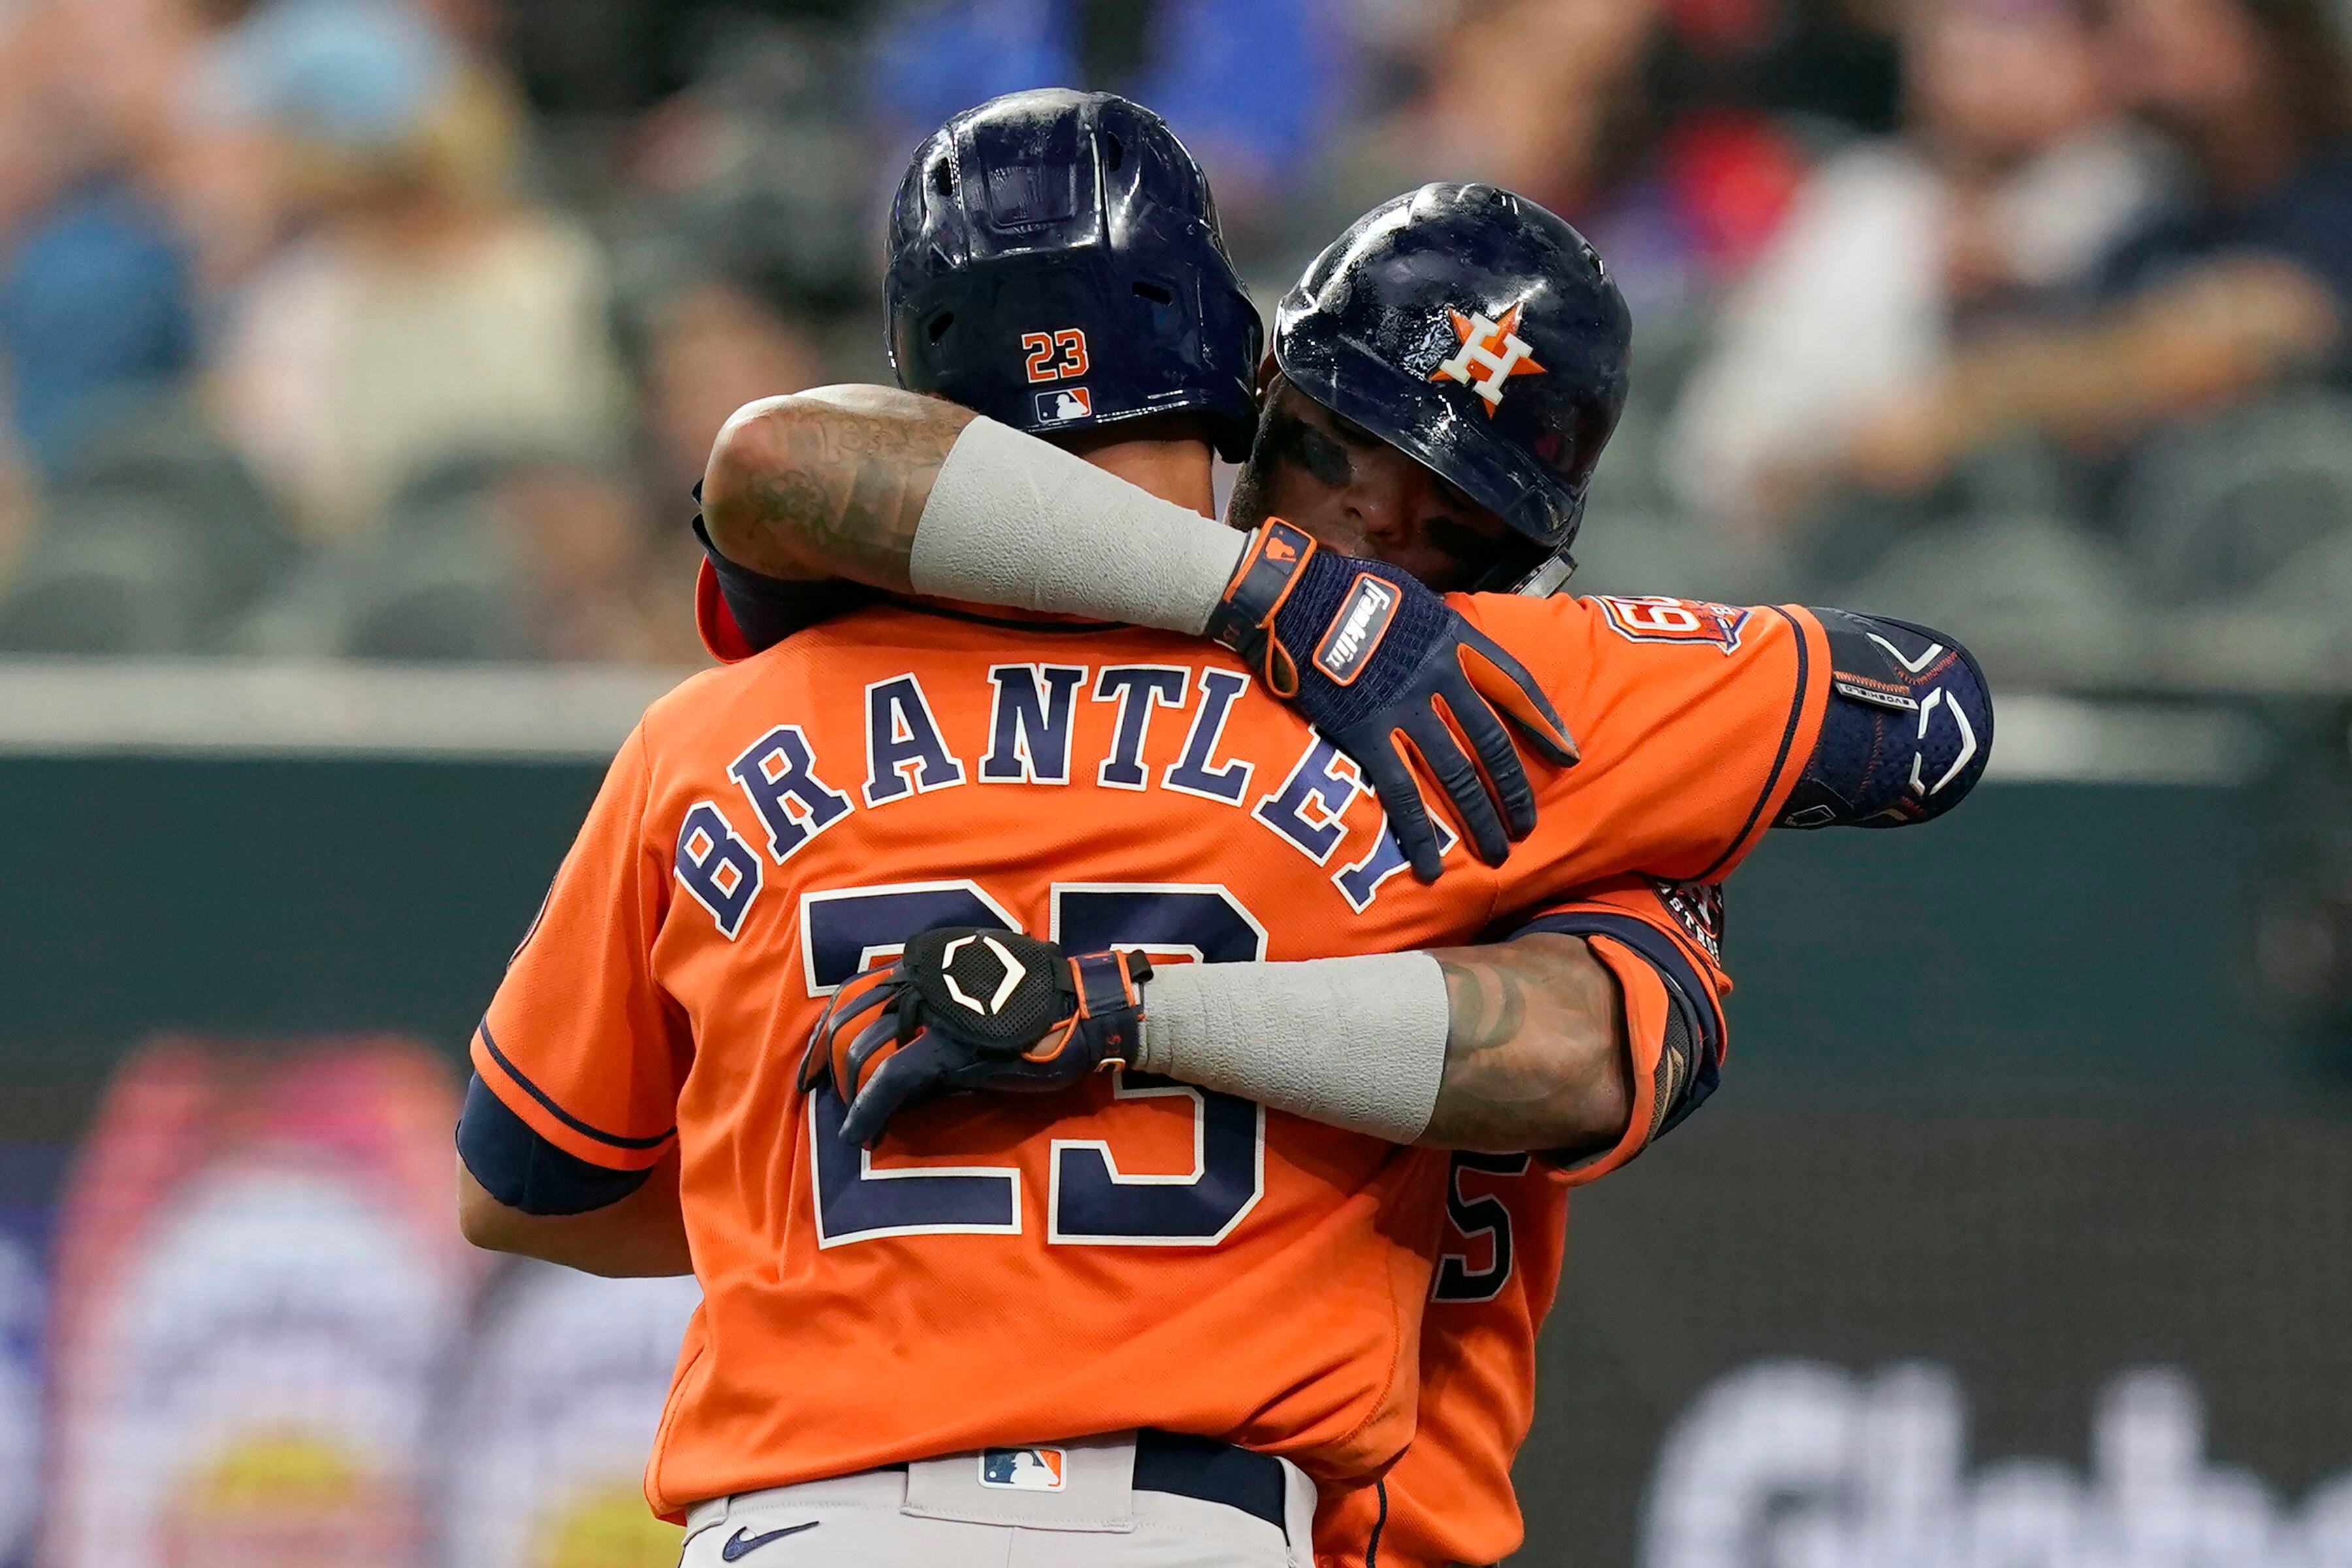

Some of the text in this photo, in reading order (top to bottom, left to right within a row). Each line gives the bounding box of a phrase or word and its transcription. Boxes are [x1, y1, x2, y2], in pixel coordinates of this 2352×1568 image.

[1021, 327, 1090, 384] 23
[1439, 311, 1533, 406] H
[1844, 685, 1910, 706] EVOSHIELD
[800, 879, 1269, 1250] 23
[1430, 1150, 1531, 1304] 5
